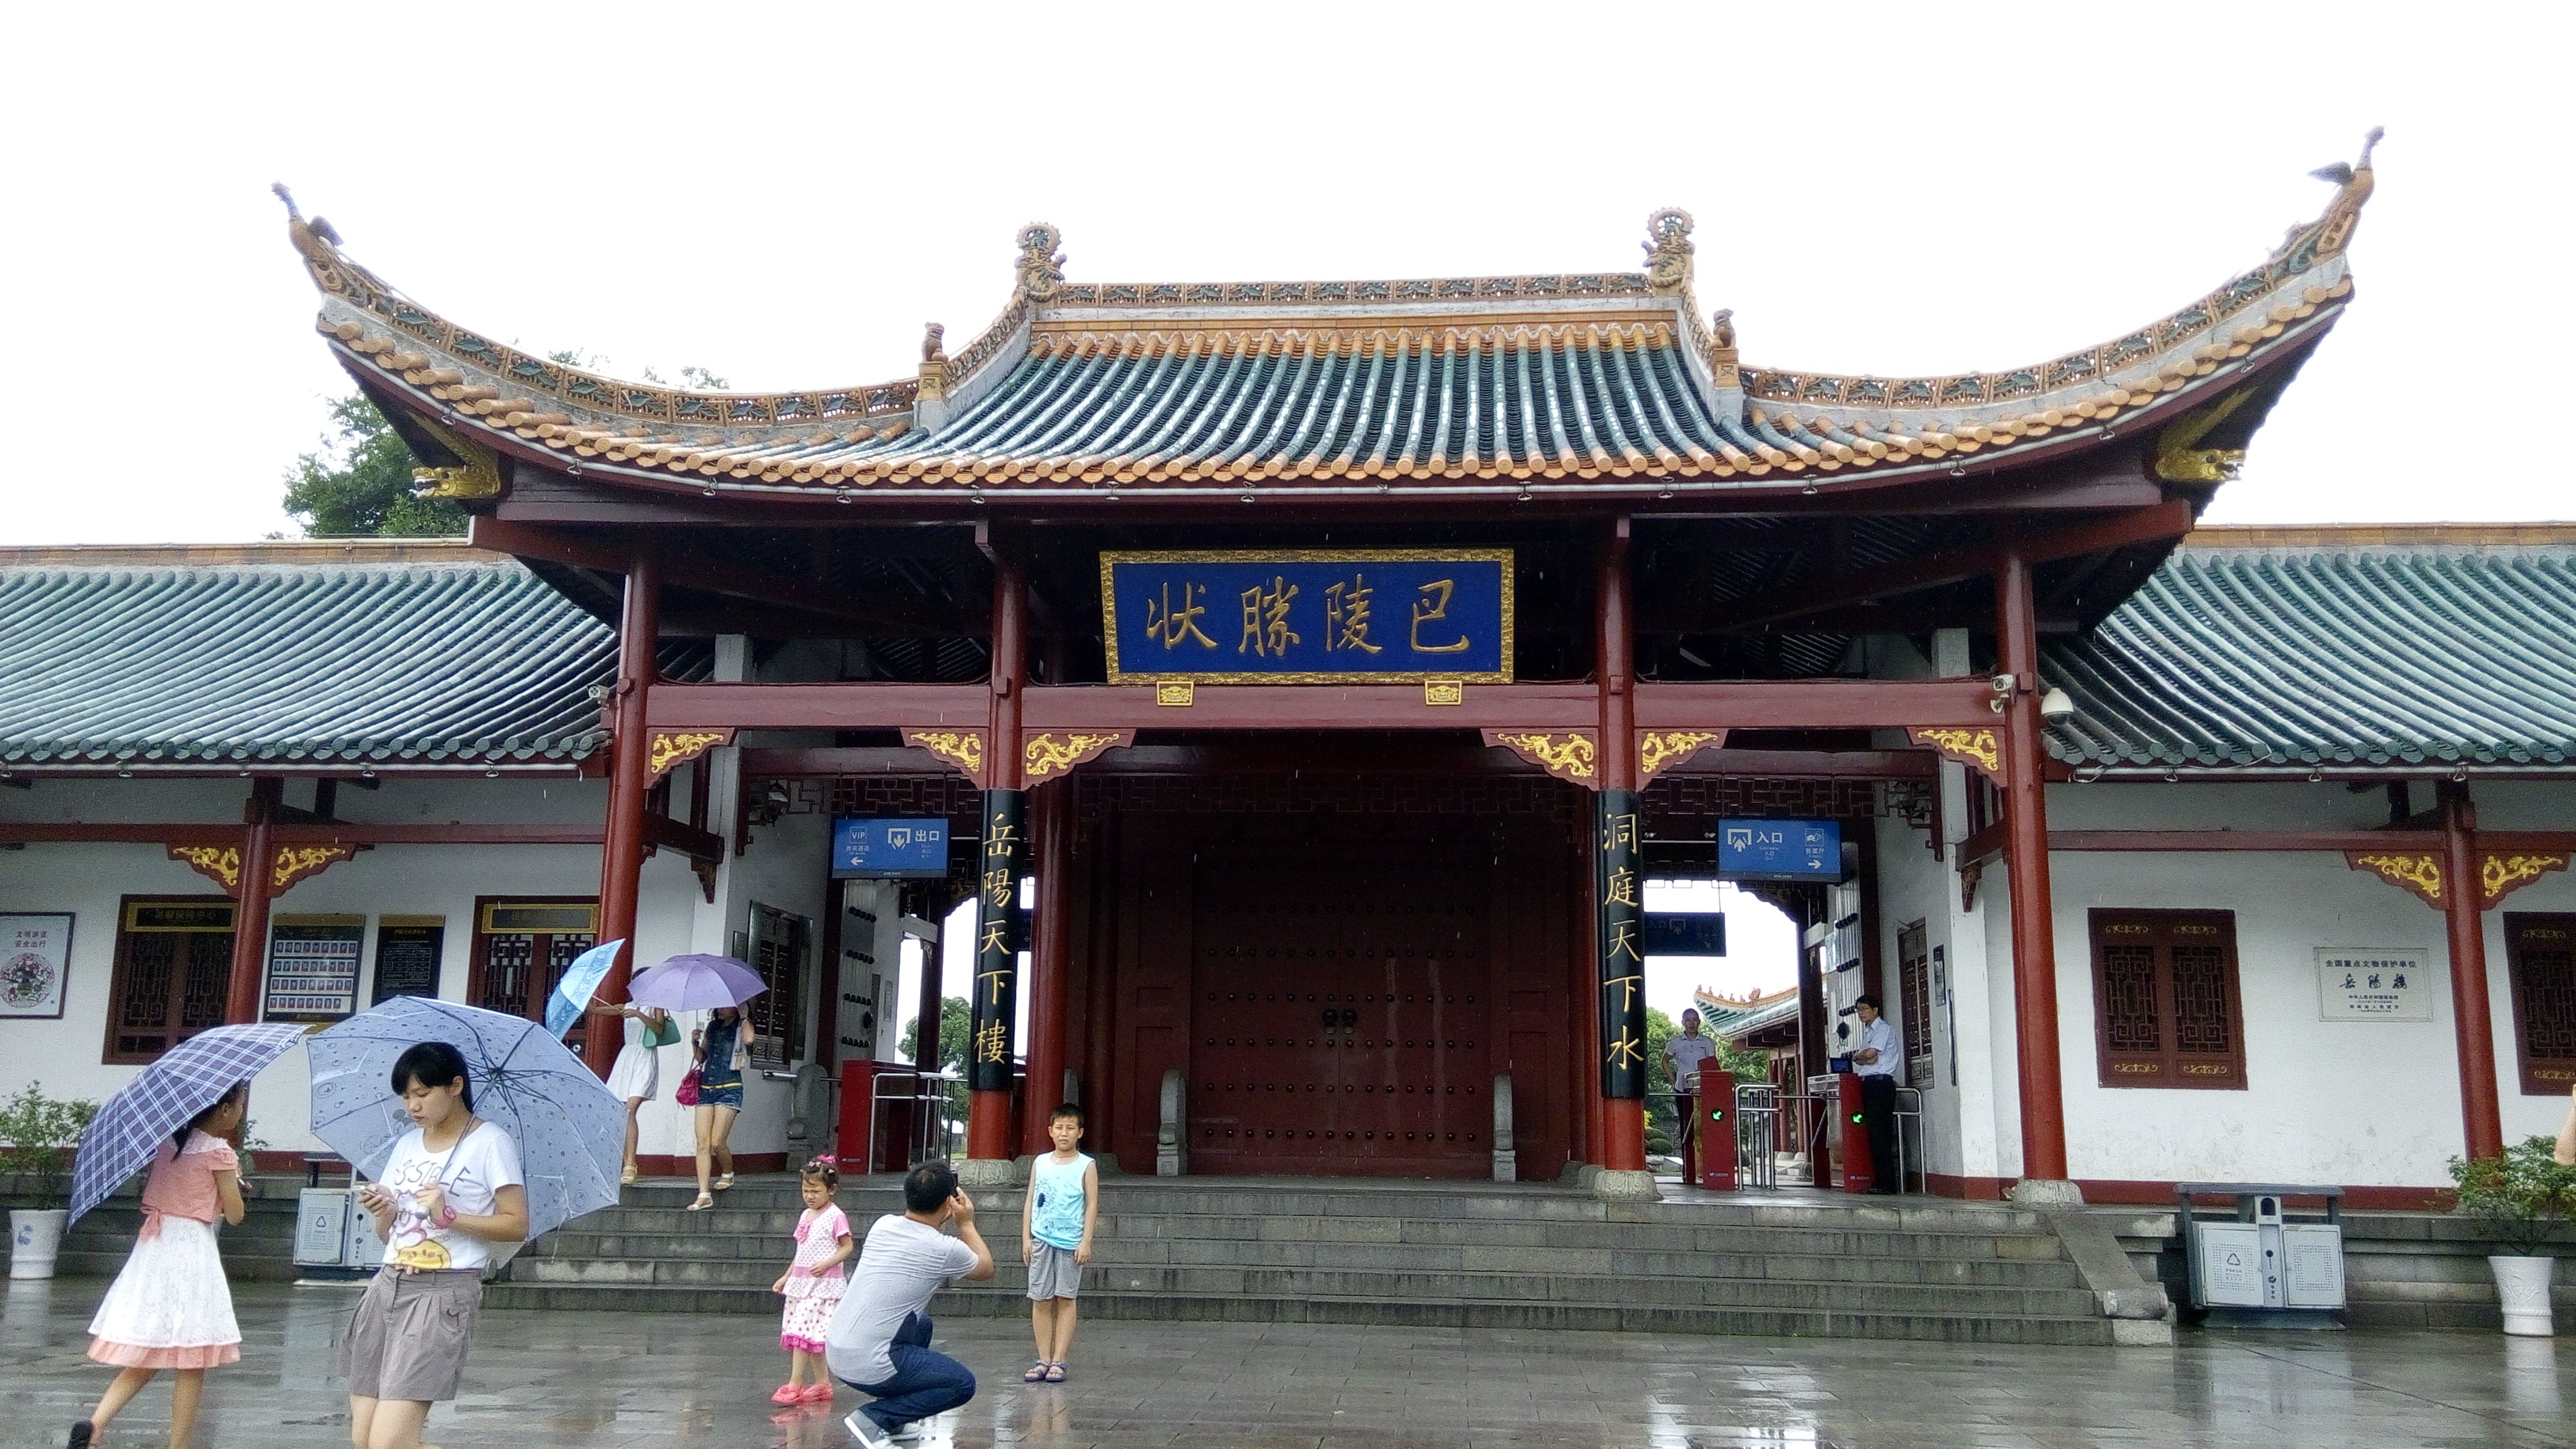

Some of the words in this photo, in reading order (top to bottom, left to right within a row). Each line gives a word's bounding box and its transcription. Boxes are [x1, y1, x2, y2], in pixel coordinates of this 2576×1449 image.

[915, 829, 940, 842] 出口
[1756, 831, 1783, 844] 入口
[974, 812, 1020, 1065] 岳陽天下樓
[1603, 813, 1645, 1070] 洞庭天下水
[2325, 960, 2416, 968] 全国重点文物保护单位
